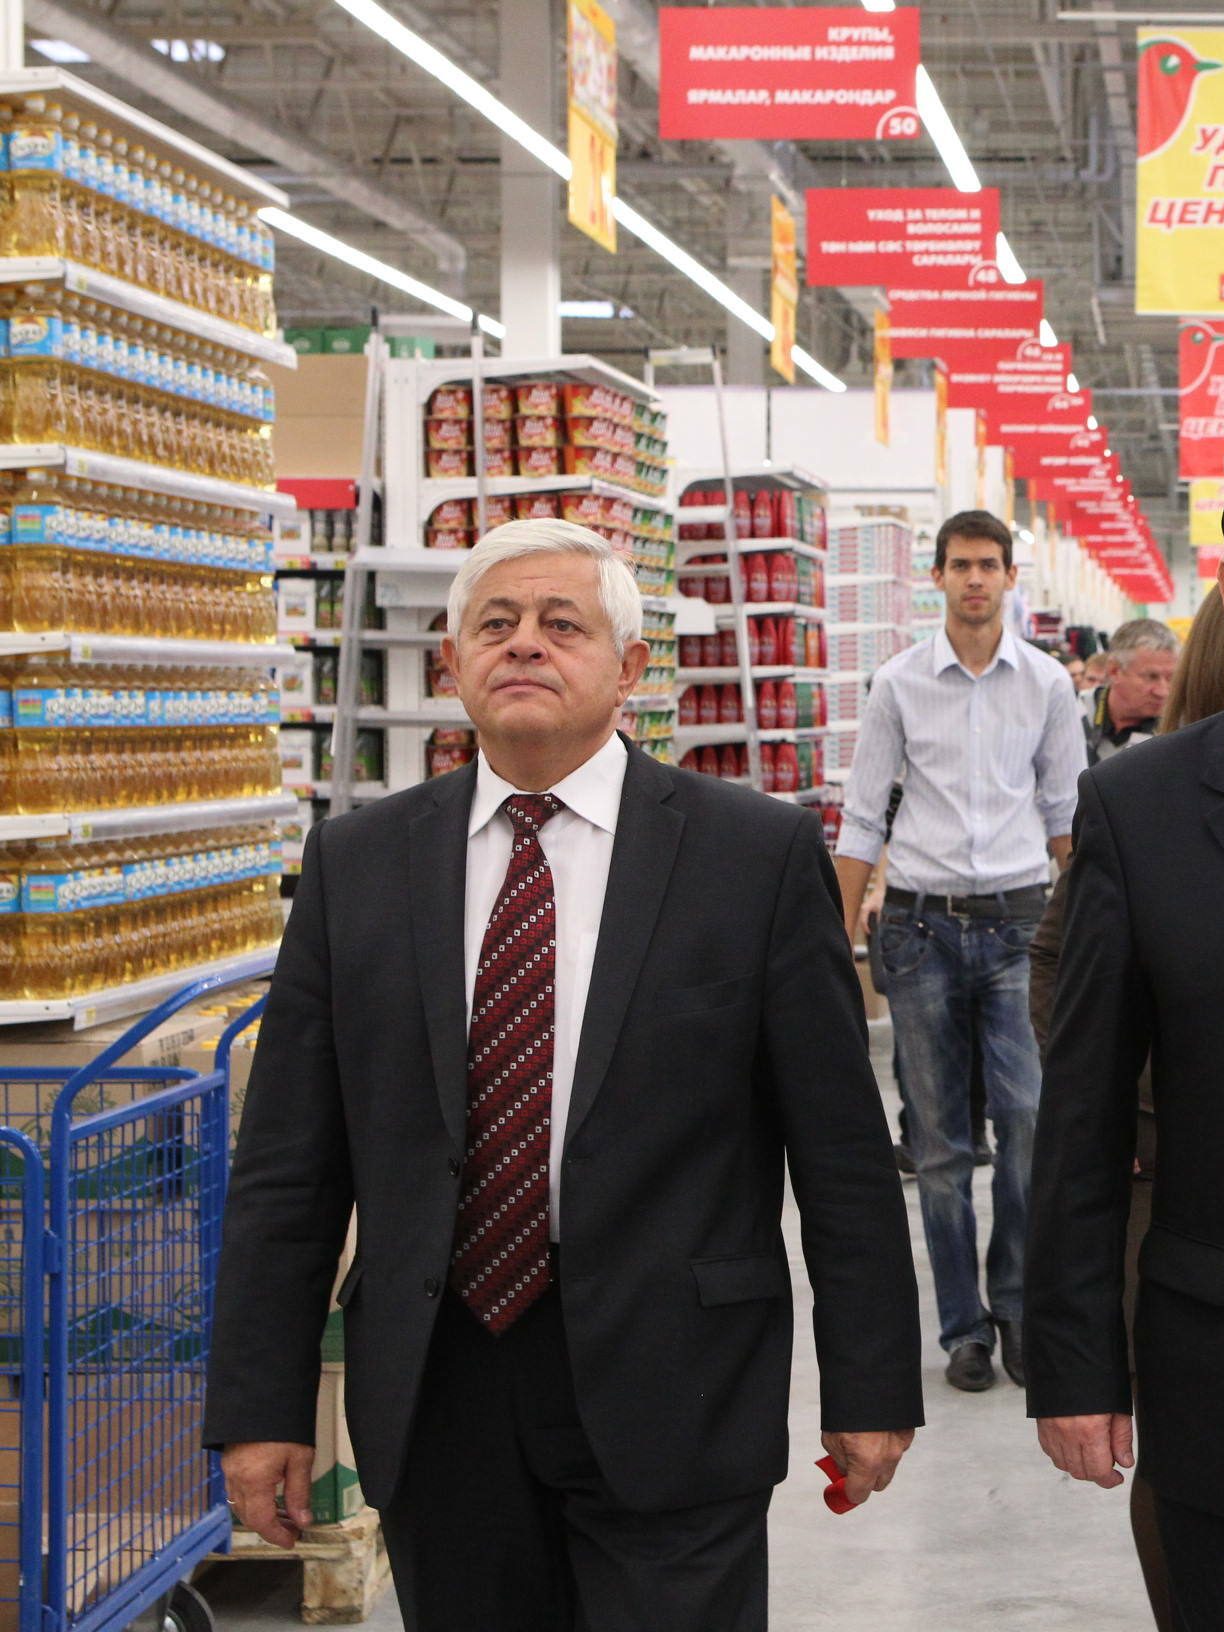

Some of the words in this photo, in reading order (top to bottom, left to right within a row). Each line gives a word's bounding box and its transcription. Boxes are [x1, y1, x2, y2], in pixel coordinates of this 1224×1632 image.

[827, 27, 894, 43] КРУПЫ,
[689, 45, 812, 60] МАКАРОННЫЕ
[815, 45, 894, 63] ИЗДЕЛИЯ
[774, 89, 896, 106] МАКАРОНДАР
[889, 117, 917, 135] 50
